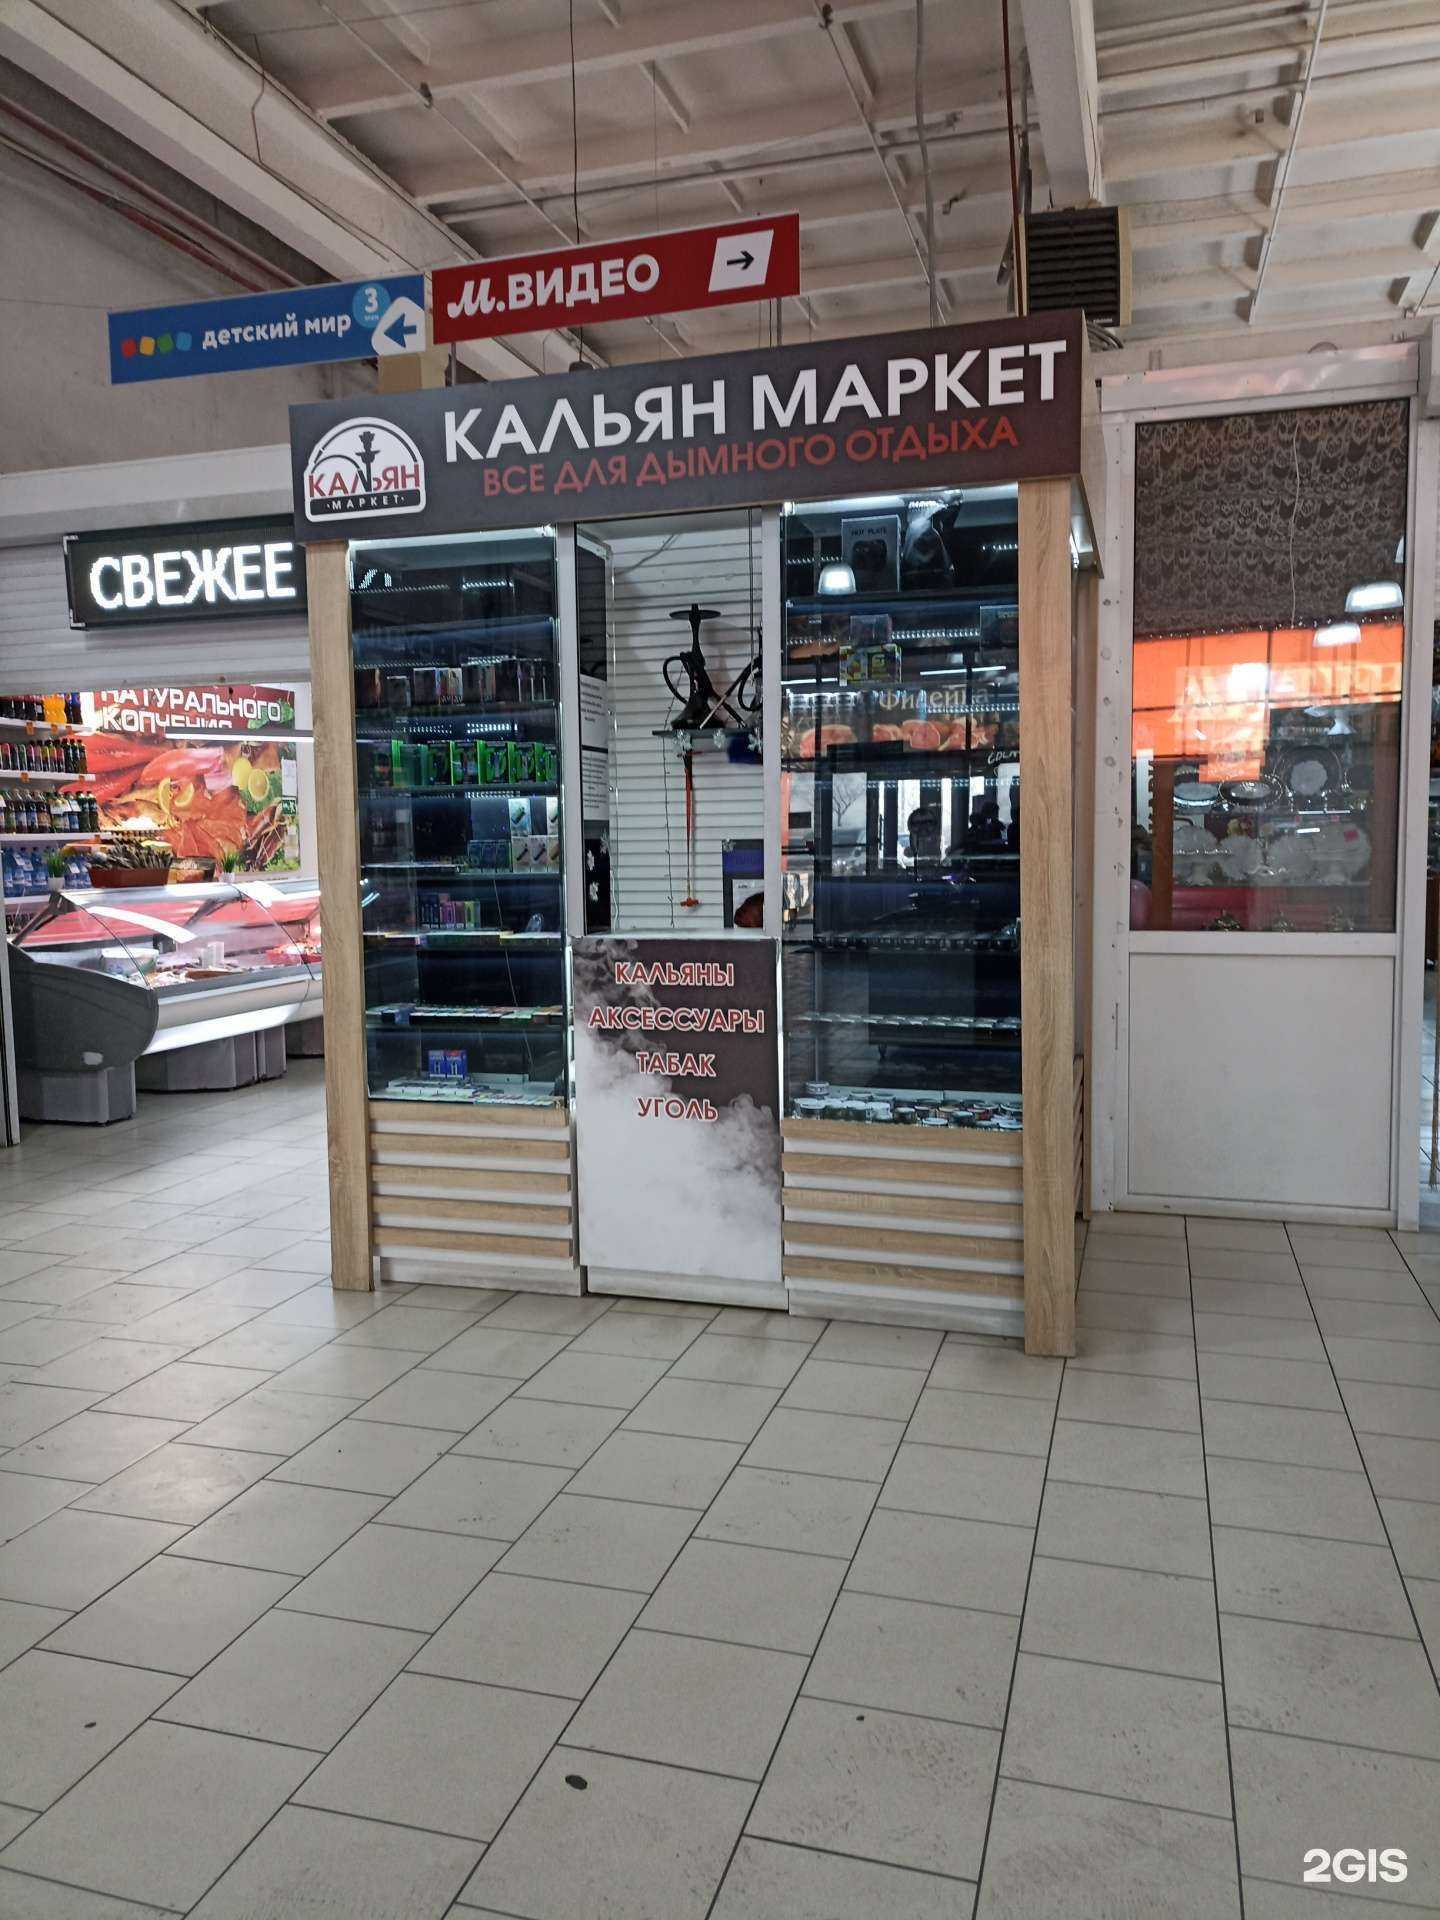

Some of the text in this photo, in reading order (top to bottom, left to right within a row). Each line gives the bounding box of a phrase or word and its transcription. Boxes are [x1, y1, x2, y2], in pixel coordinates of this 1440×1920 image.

[364, 287, 379, 313] 3
[202, 312, 351, 350] детский мир
[444, 340, 1067, 463] КАЛЬЯН МАРКЕТ
[483, 416, 1020, 497] ВСЕ ДЛЯ ДЫМНОГО ОТДЫХА
[308, 463, 420, 498] КАЛЬЯН
[331, 494, 399, 511] МАРКЕТ
[90, 542, 296, 609] СВЕЖЕЕ
[615, 961, 735, 986] КАЛЬЯНЫ
[588, 1006, 765, 1033] АКСЕССУАРЫ
[636, 1051, 716, 1077] ТАБАК
[637, 1097, 718, 1121] УГОЛЬ
